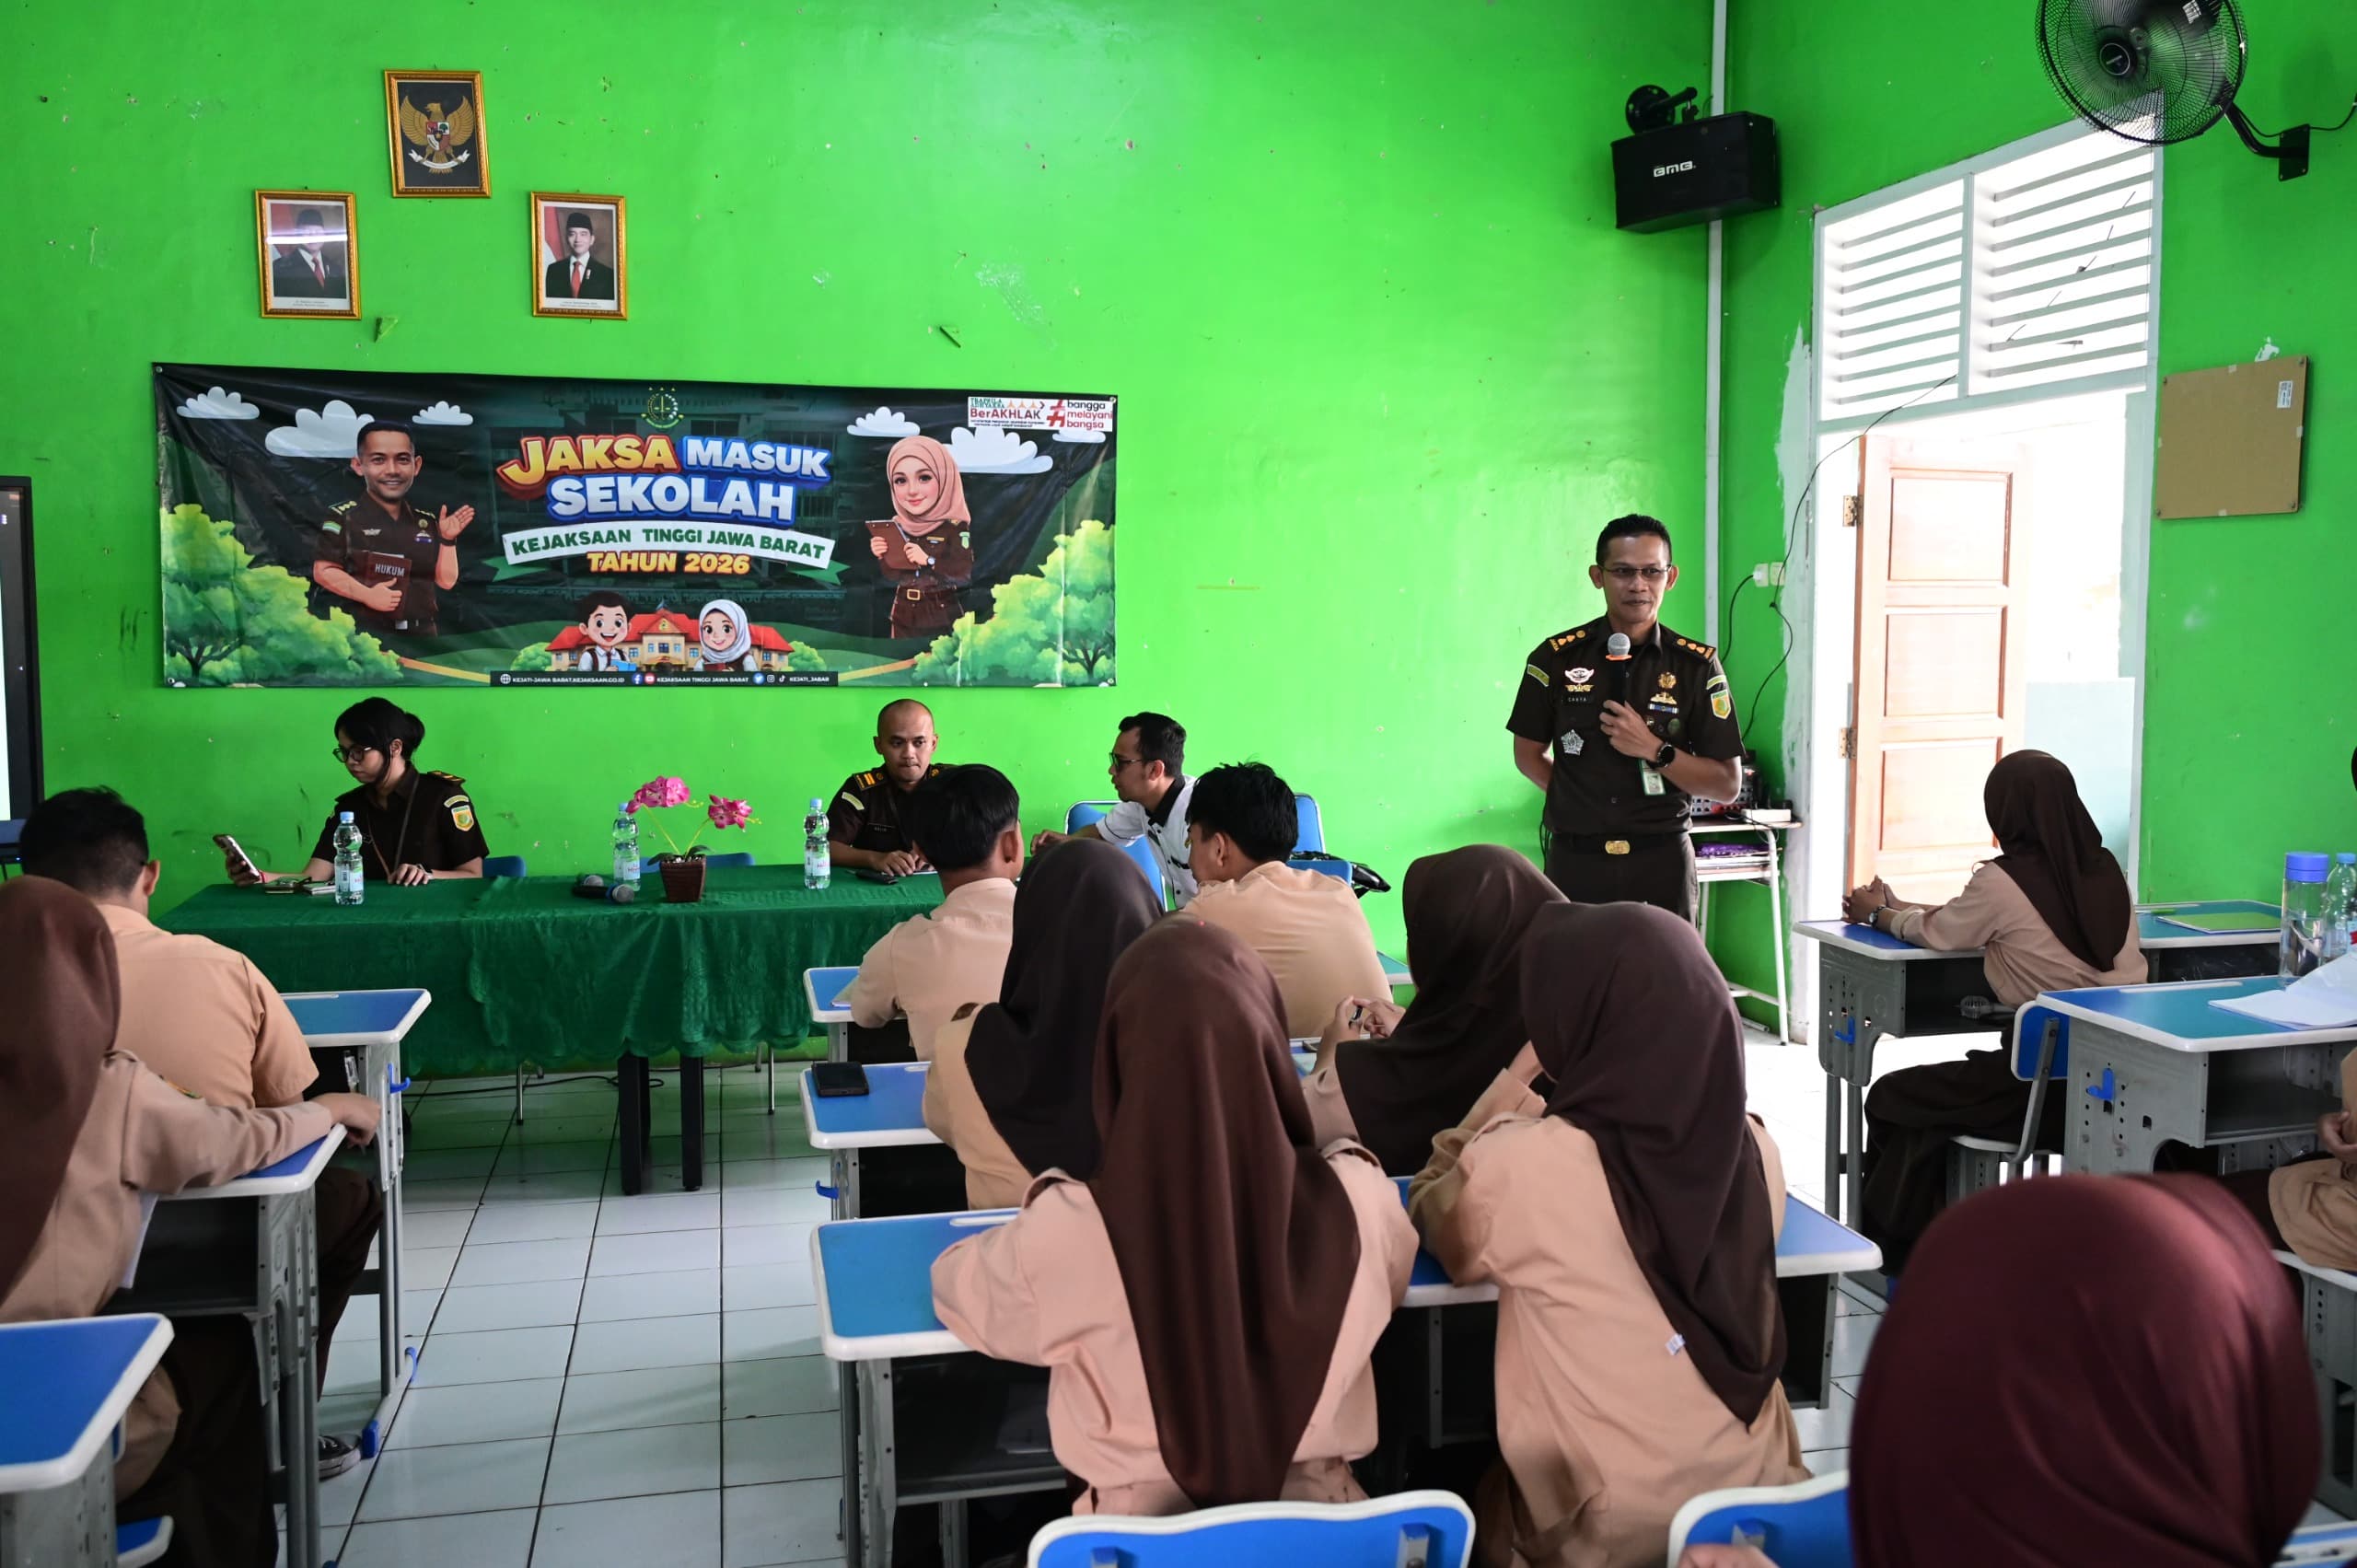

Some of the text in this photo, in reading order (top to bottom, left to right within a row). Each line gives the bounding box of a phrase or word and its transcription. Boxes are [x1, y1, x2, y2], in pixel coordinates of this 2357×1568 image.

[1067, 401, 1106, 411] bangga
[970, 408, 1040, 419] BerAKHLAK
[1066, 411, 1113, 420] melayani
[1066, 420, 1105, 430] bangsa
[499, 436, 830, 488] JAKSA MASUK
[550, 474, 795, 523] SEKOLAH
[512, 528, 826, 560] KEJAKSAAN TINGGI JAWA BARAT
[375, 563, 405, 577] HUKUM
[586, 551, 751, 575] TAHUN 2026
